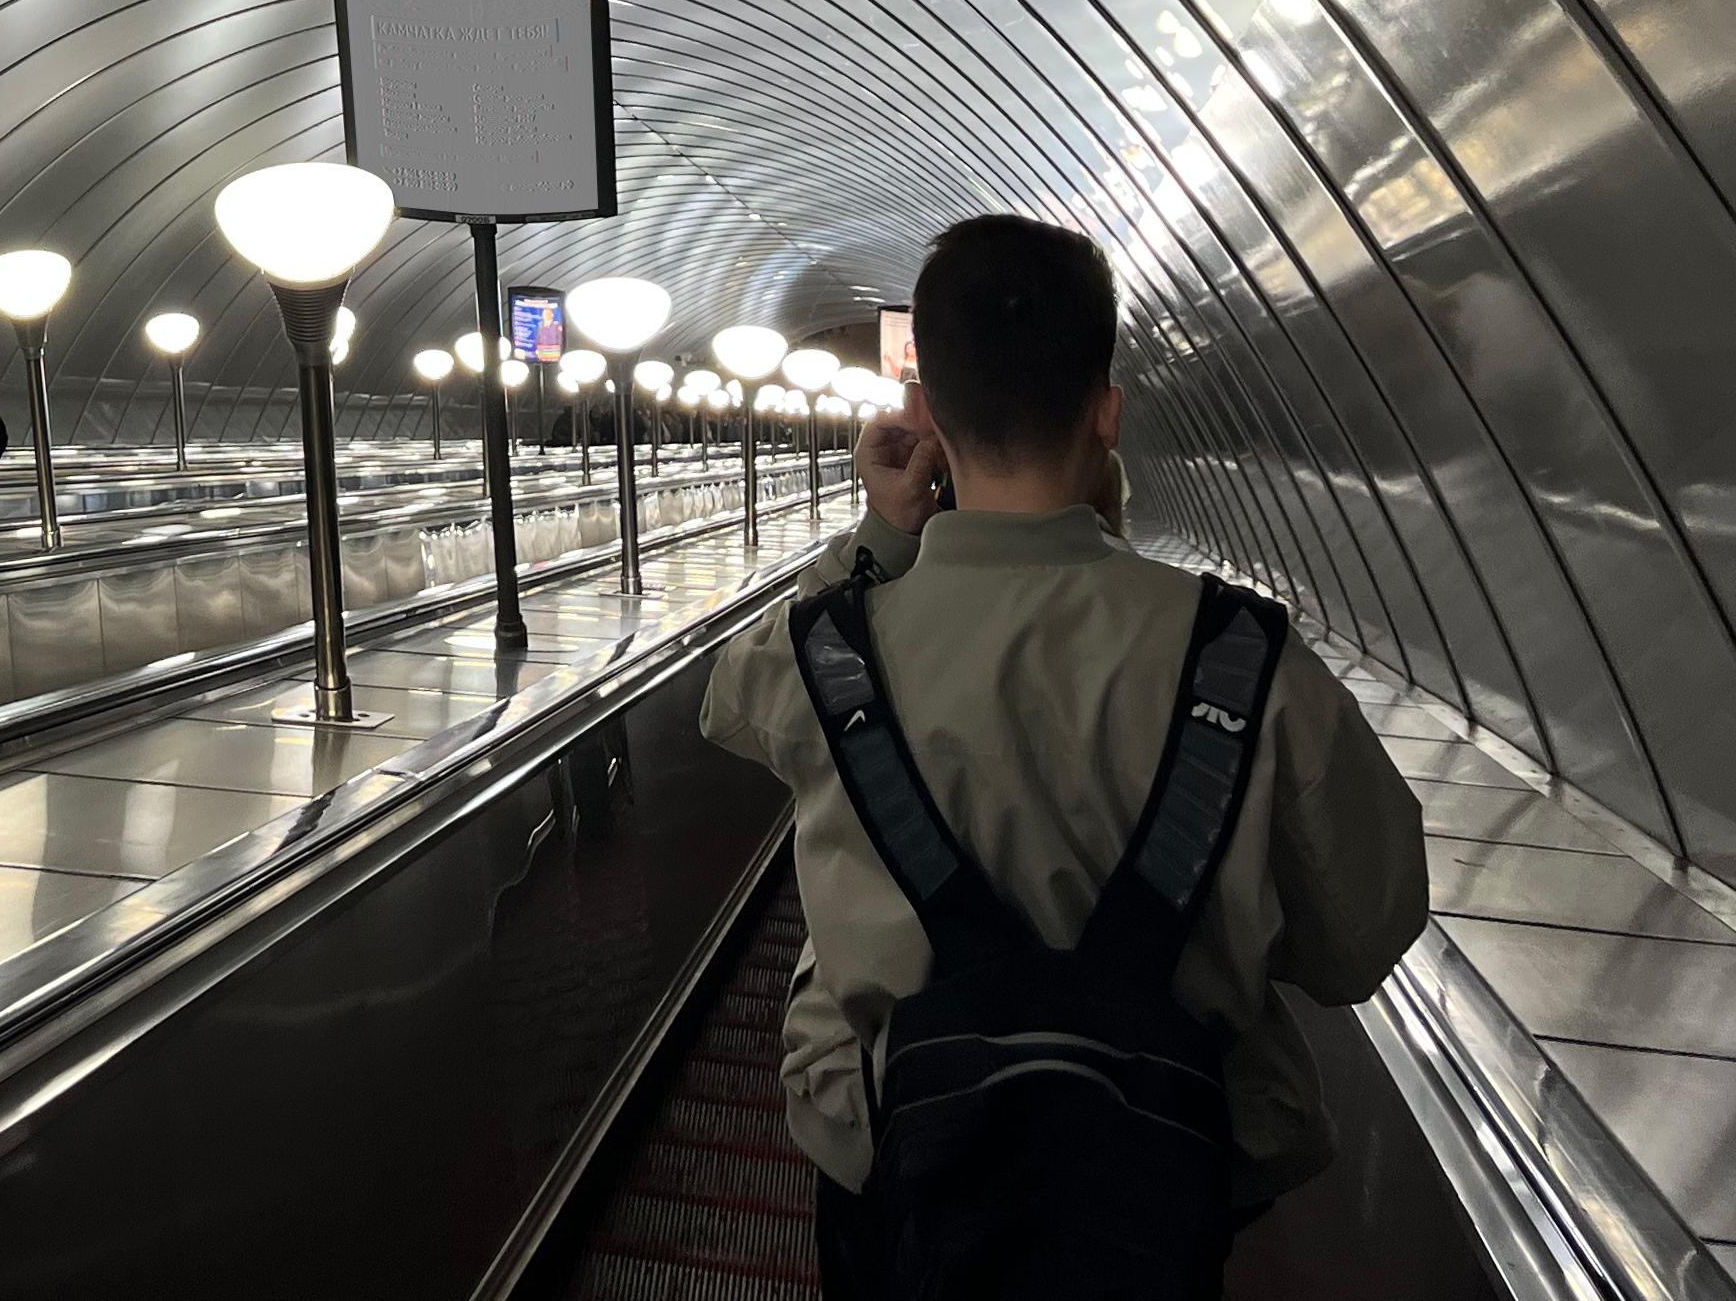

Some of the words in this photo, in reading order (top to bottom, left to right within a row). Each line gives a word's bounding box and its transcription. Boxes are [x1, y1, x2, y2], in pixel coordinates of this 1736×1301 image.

[377, 22, 456, 42] КАМЧАТКА
[459, 27, 502, 43] ЖДЕТ
[508, 24, 549, 41] ТЕБЯ!
